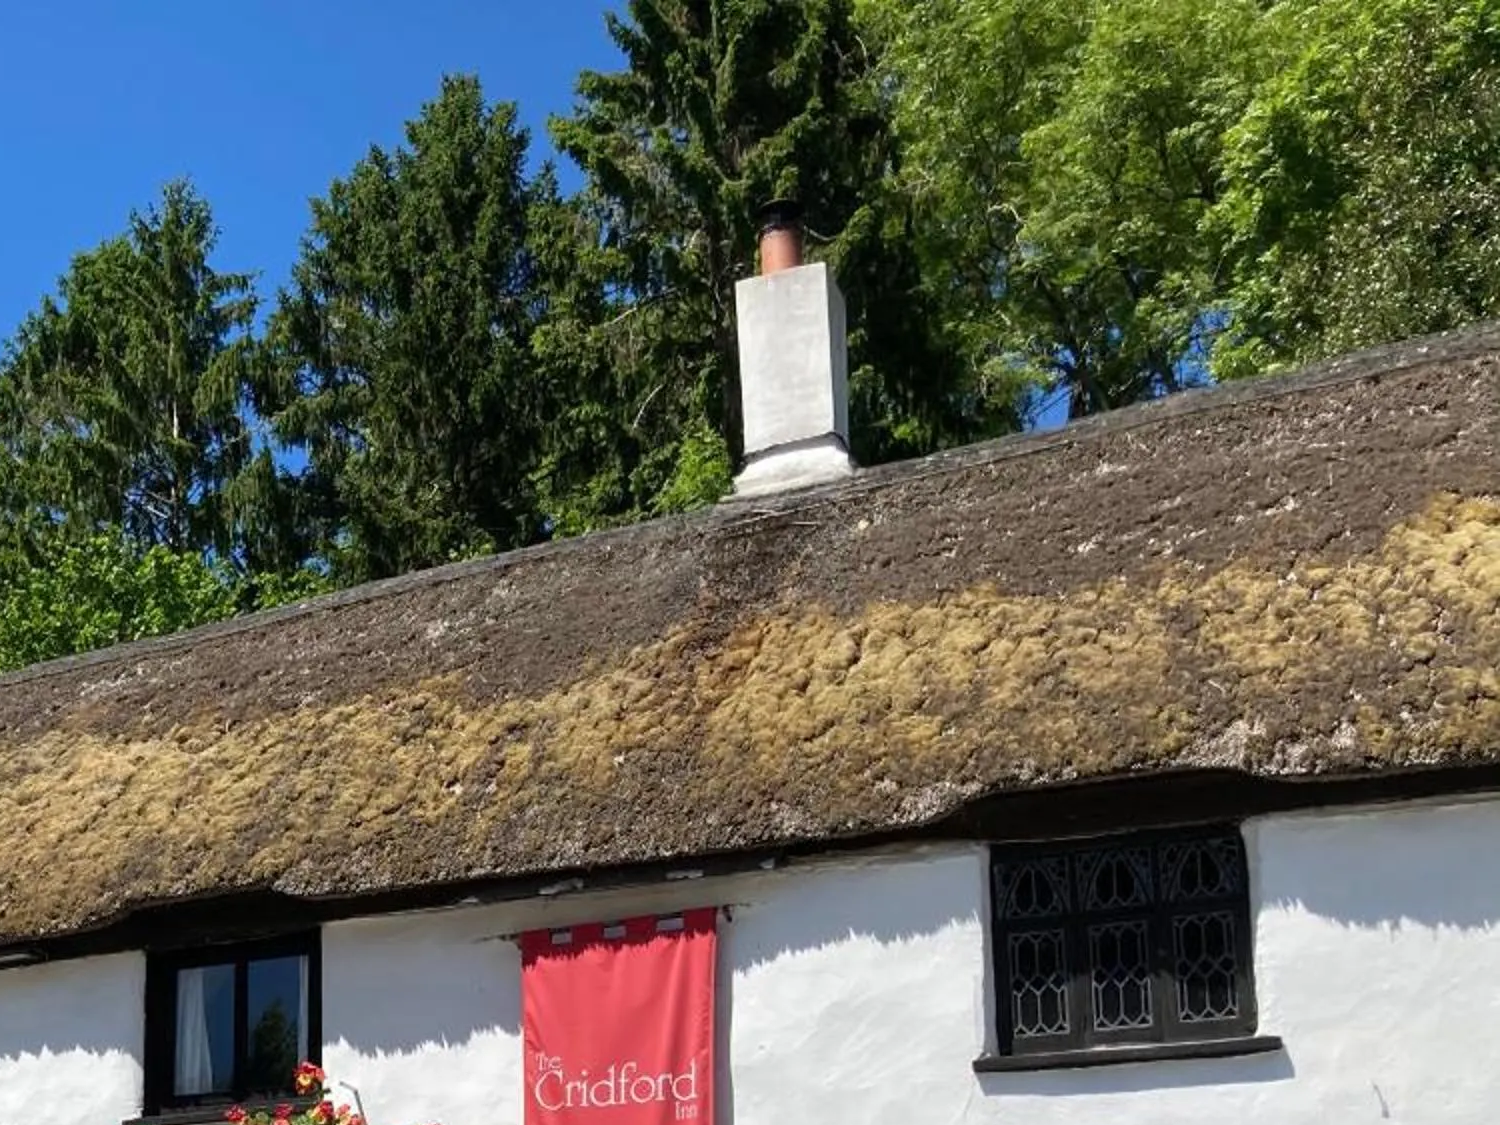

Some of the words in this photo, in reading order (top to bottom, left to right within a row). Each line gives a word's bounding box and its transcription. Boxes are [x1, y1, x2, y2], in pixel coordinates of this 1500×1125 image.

[535, 1051, 562, 1071] The
[535, 1058, 698, 1111] Cridford
[675, 1101, 698, 1121] Inn
